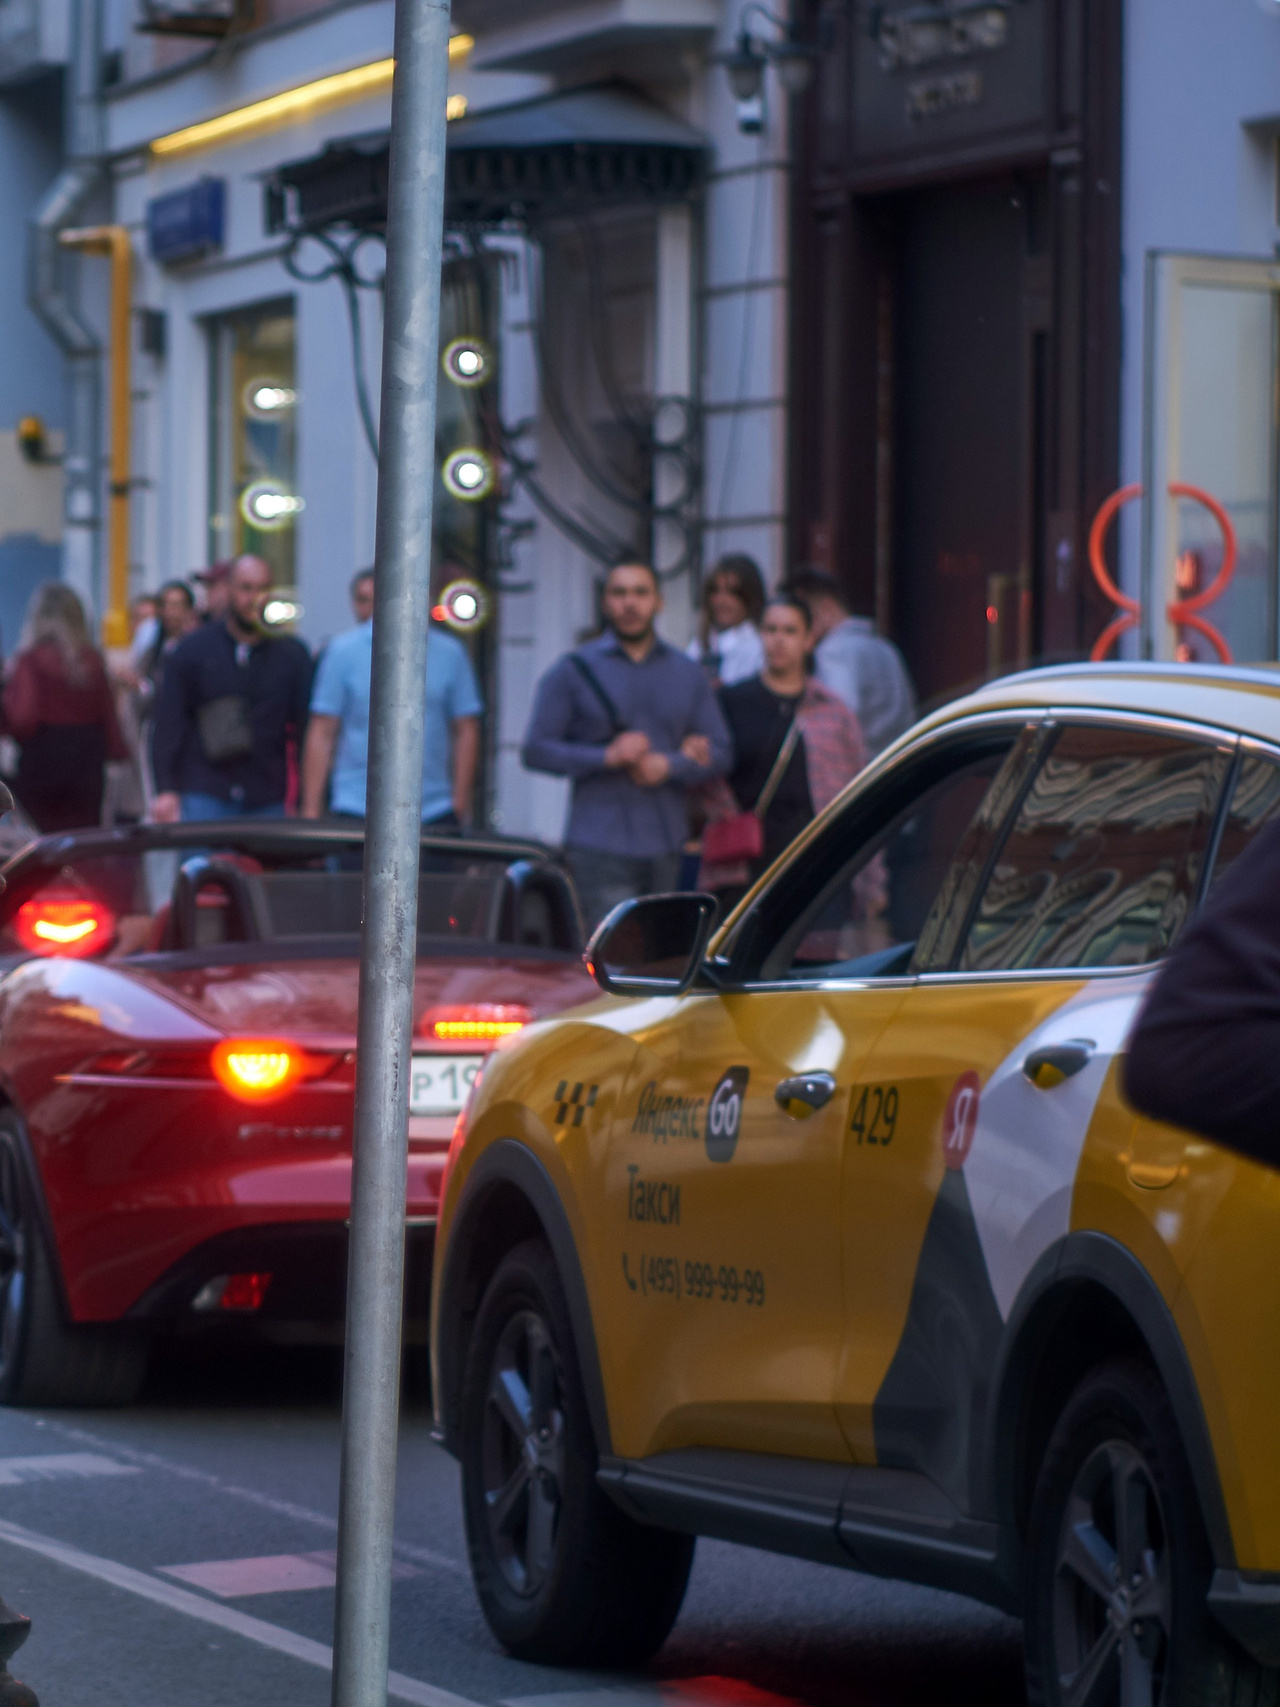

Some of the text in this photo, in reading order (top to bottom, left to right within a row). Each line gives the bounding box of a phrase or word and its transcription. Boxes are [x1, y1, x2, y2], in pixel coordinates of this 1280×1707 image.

[631, 1080, 704, 1144] Яндекс
[851, 1085, 899, 1146] 429
[948, 1087, 974, 1150] Я
[627, 1163, 681, 1226] Такси
[640, 1253, 765, 1307] (495) 999-99-99
